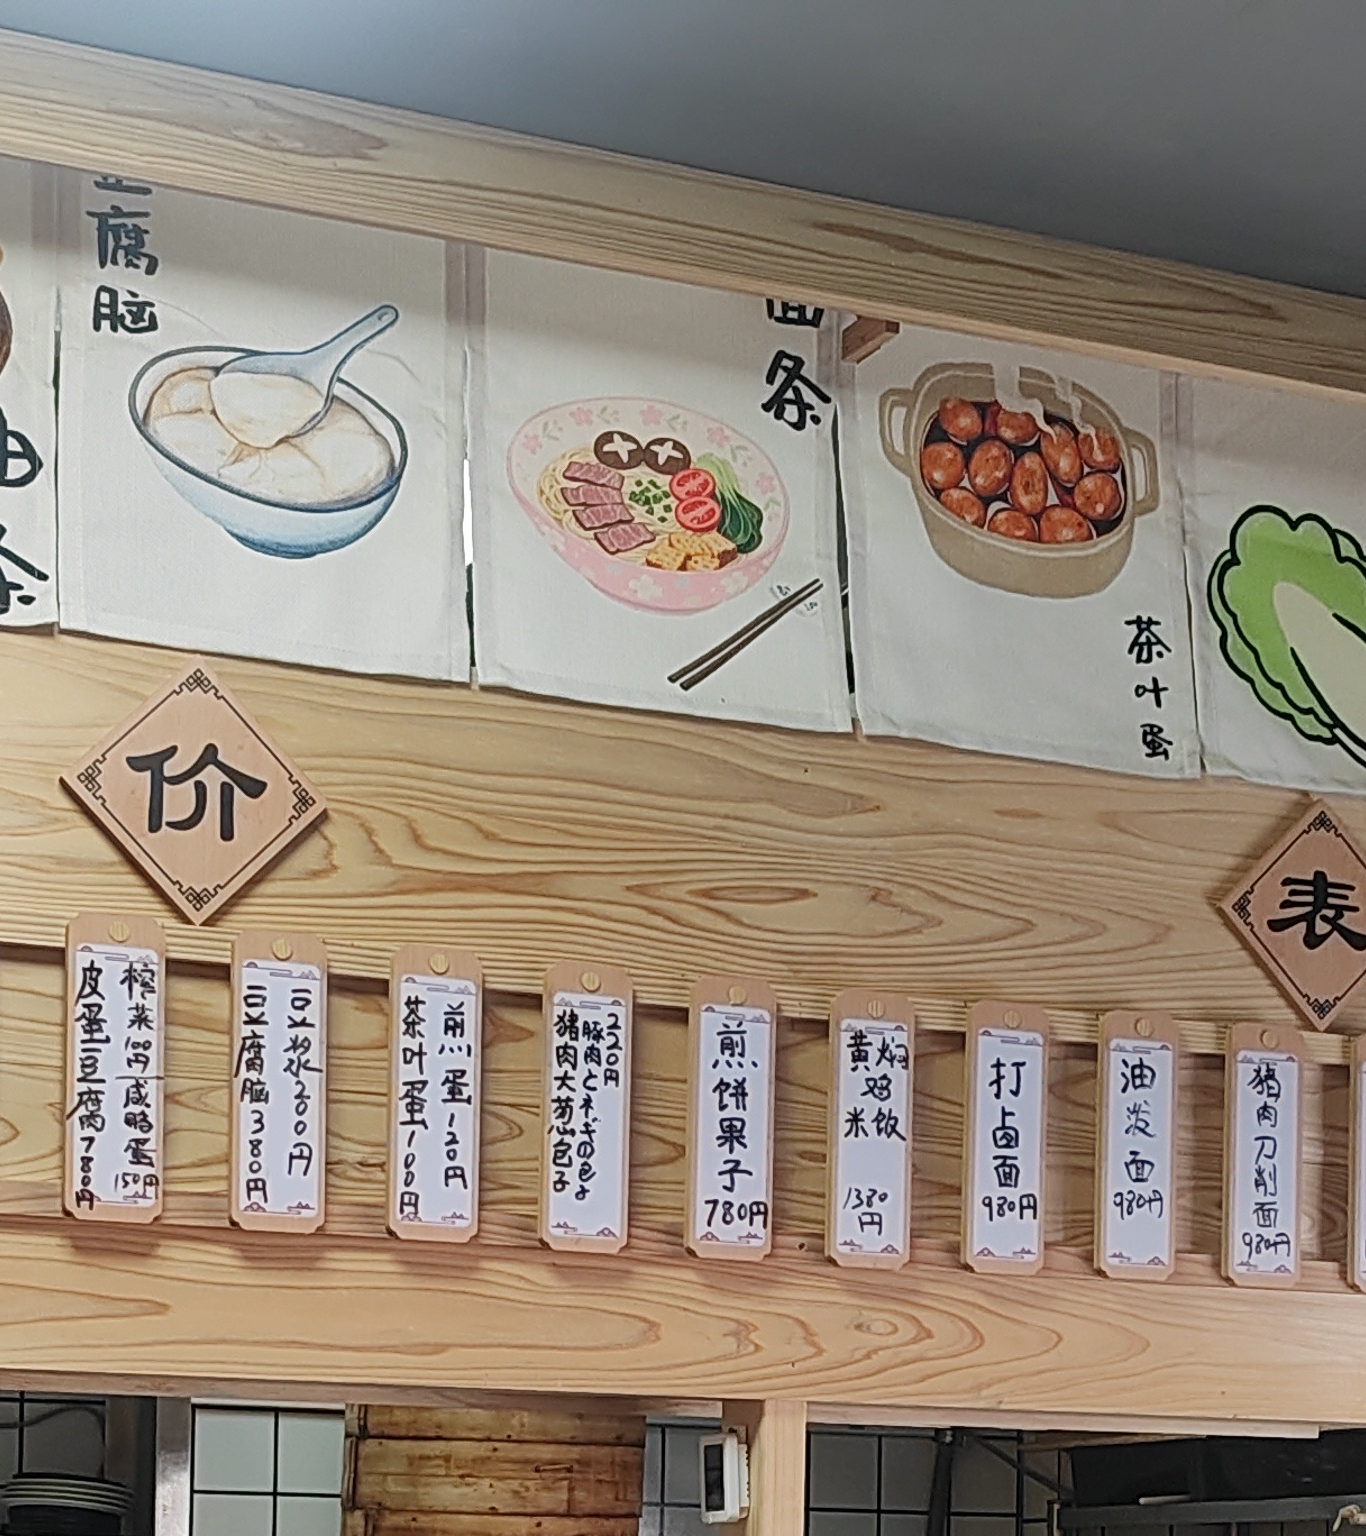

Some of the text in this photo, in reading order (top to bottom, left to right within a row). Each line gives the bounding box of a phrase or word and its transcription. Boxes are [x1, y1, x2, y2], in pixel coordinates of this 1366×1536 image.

[1124, 614, 1173, 764] 茶叶蛋
[126, 743, 268, 842] 价
[603, 1012, 623, 1088] 220円
[704, 1199, 768, 1229] 780円
[857, 1212, 883, 1236] 円
[981, 1193, 1038, 1222] 980円
